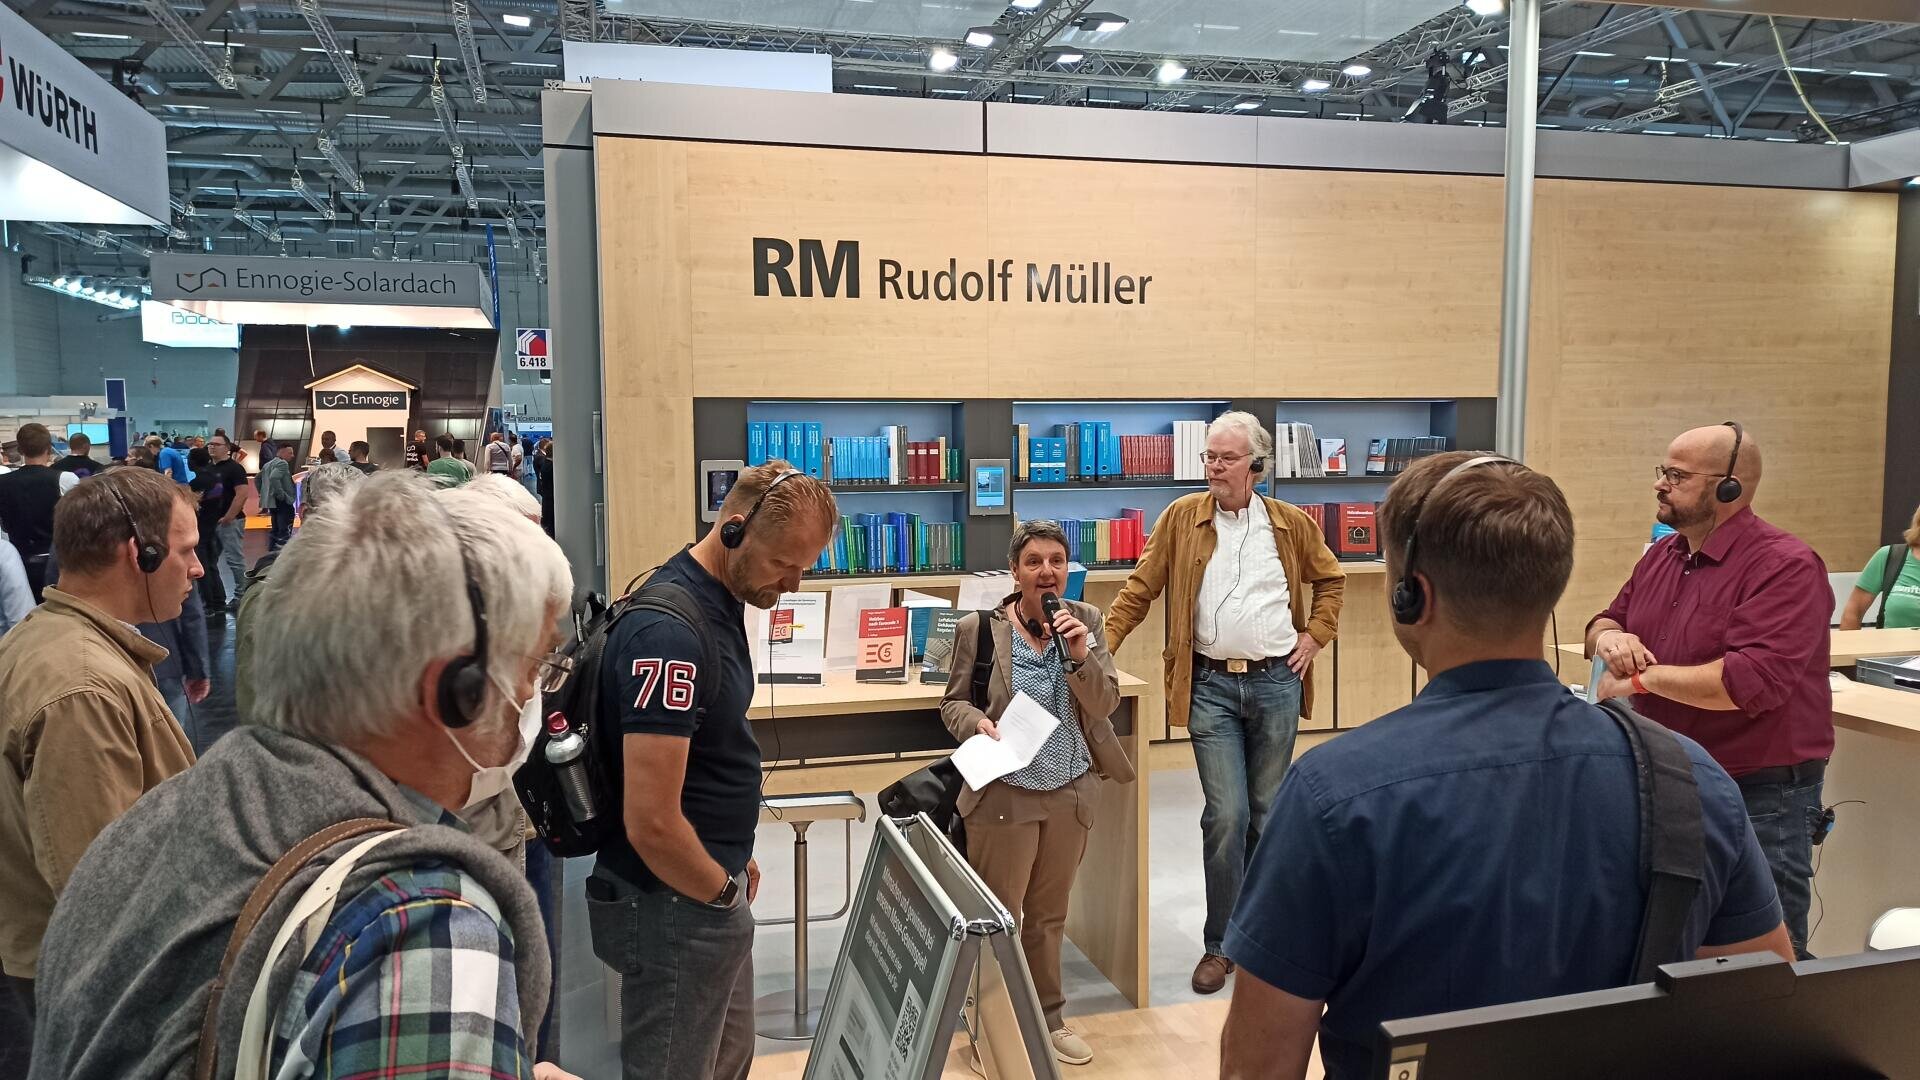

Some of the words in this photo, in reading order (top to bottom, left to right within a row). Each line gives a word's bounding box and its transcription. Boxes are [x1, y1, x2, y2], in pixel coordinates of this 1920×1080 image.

[9, 56, 98, 155] WÜRTH
[236, 268, 456, 296] Ennogie-Solardach
[753, 237, 860, 299] RM
[879, 258, 1014, 302] Rudolf
[1026, 262, 1153, 305] Müller
[519, 356, 547, 368] 6.418
[352, 393, 400, 408] Ennogie
[632, 658, 697, 711] 76
